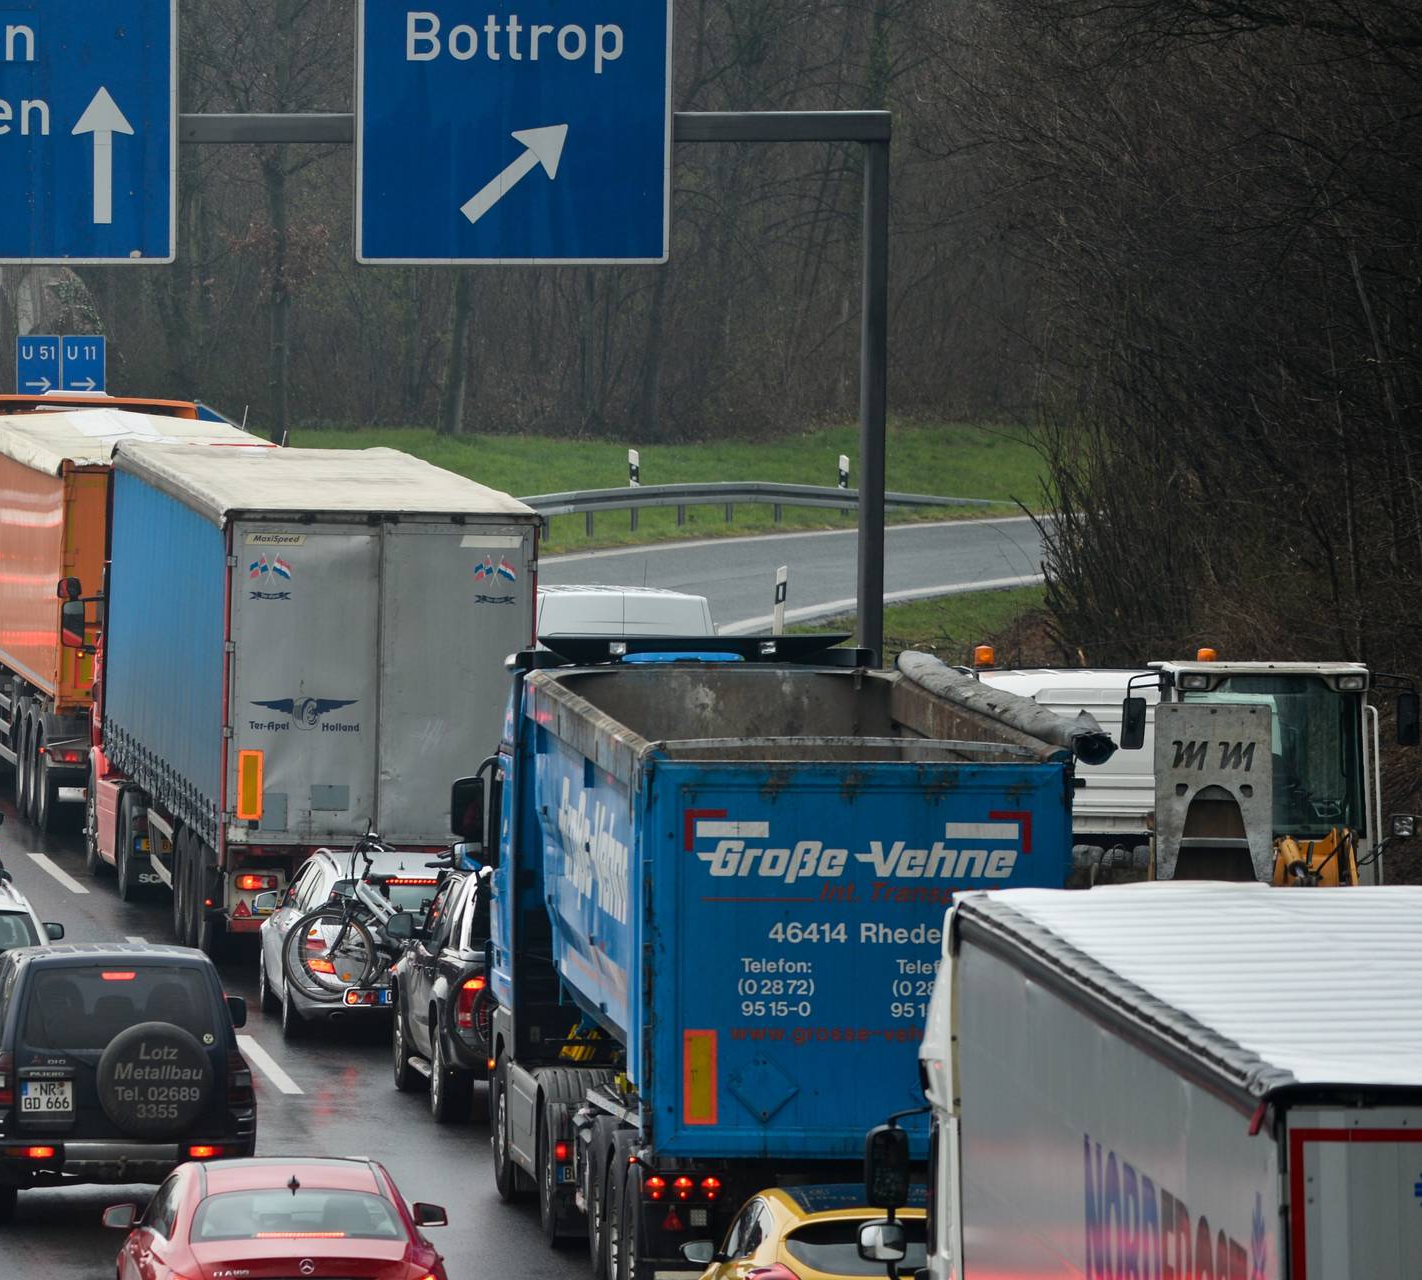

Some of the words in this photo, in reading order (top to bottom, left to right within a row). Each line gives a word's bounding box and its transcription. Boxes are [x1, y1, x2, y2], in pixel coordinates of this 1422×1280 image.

[406, 12, 624, 74] Bottrop
[22, 346, 34, 360] U
[39, 346, 56, 360] 51
[67, 346, 79, 360] U
[83, 346, 96, 360] 11
[253, 535, 300, 543] MaxiSpeed
[249, 721, 290, 731] Ter-Apel
[322, 723, 360, 732] Holland
[697, 840, 848, 883] Große
[854, 841, 1018, 878] Vehne
[819, 881, 859, 902] Int.
[769, 922, 847, 943] 46414
[860, 923, 942, 944] Rhede
[741, 958, 812, 973] Telefon:
[139, 1042, 179, 1060] Lotz
[114, 1063, 203, 1080] Metallbau
[39, 1084, 57, 1096] NR
[114, 1086, 145, 1101] Tel.
[147, 1086, 200, 1101] 02689
[24, 1097, 41, 1110] GD
[46, 1097, 71, 1110] 666
[137, 1104, 179, 1119] 3355
